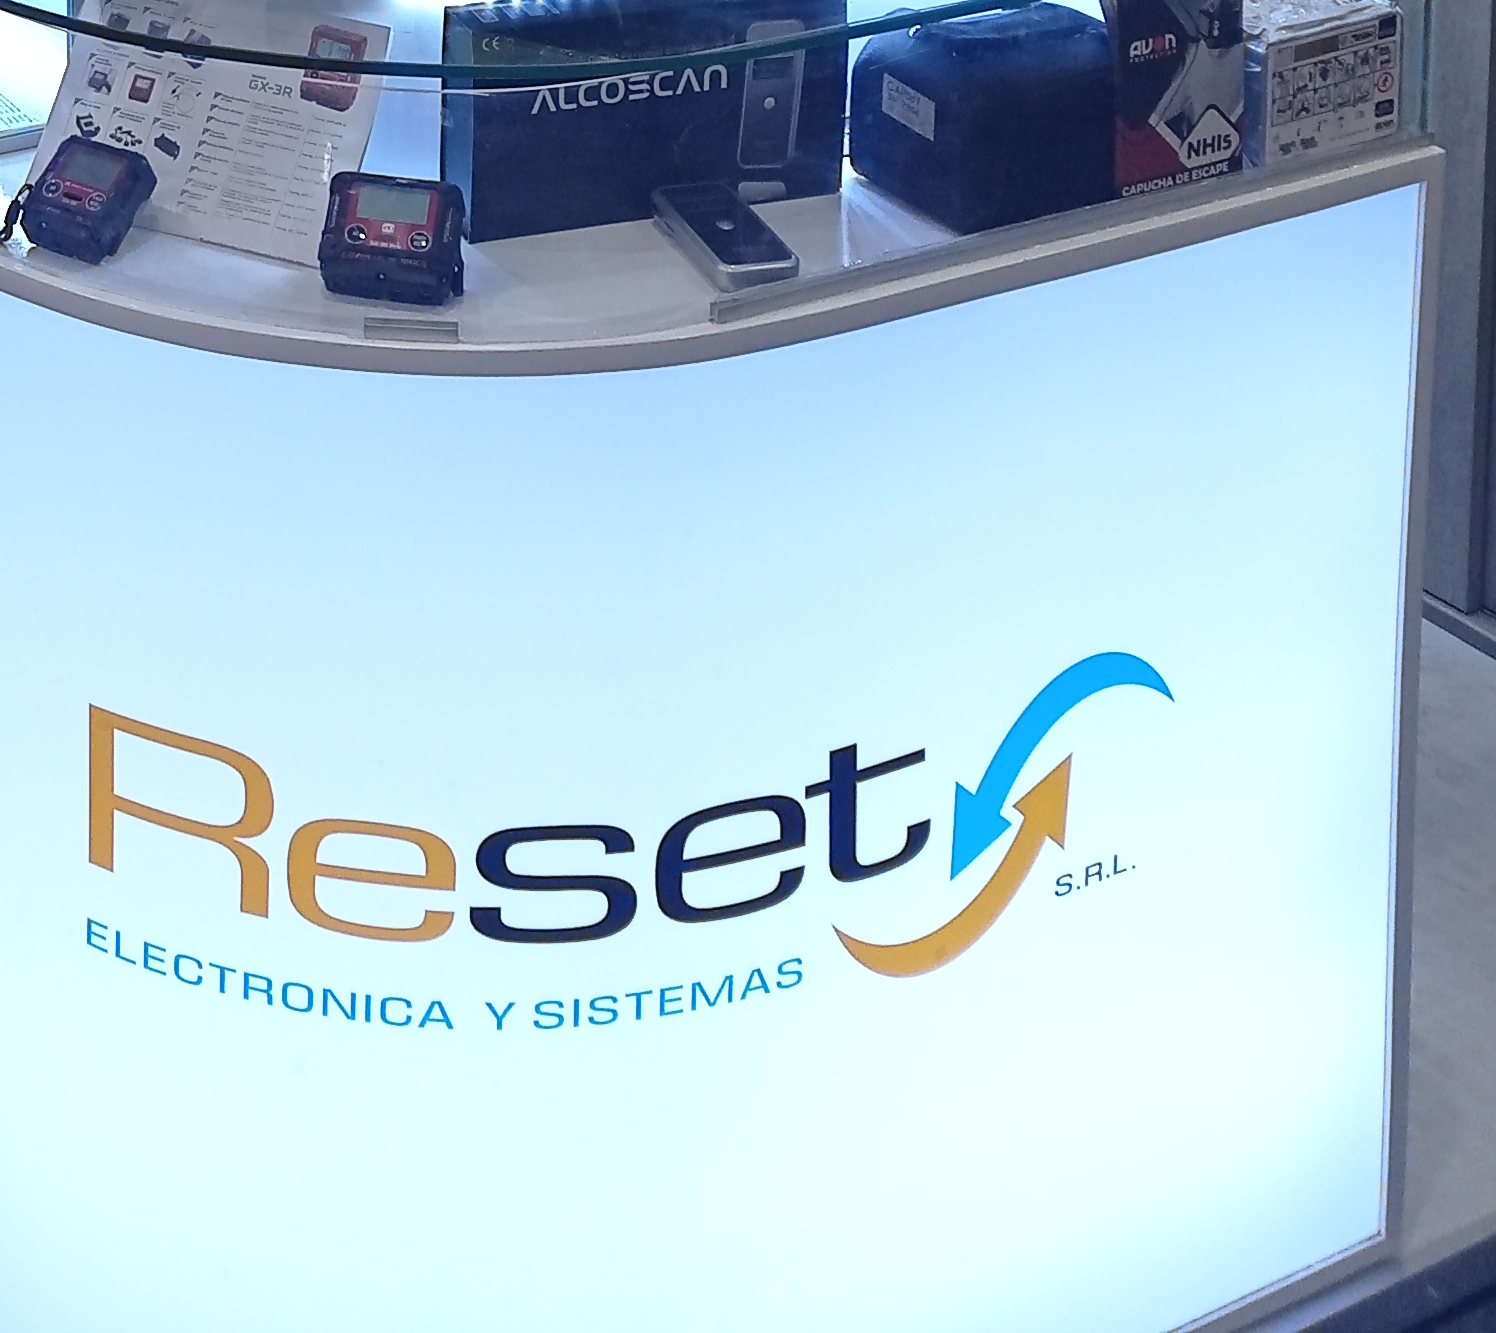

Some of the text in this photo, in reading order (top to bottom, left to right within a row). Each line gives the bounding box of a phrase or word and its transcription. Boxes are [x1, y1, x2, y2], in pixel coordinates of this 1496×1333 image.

[248, 79, 294, 99] GX-3R
[530, 63, 730, 115] ALCOSCAN
[1186, 133, 1233, 161] NHIS
[1121, 161, 1230, 197] CAPUCHA DE ESCAPE
[88, 702, 933, 946] Reset
[1053, 855, 1138, 899] S.R.L.
[85, 916, 806, 1031] ELECTRONICA Y SISTEMAS
